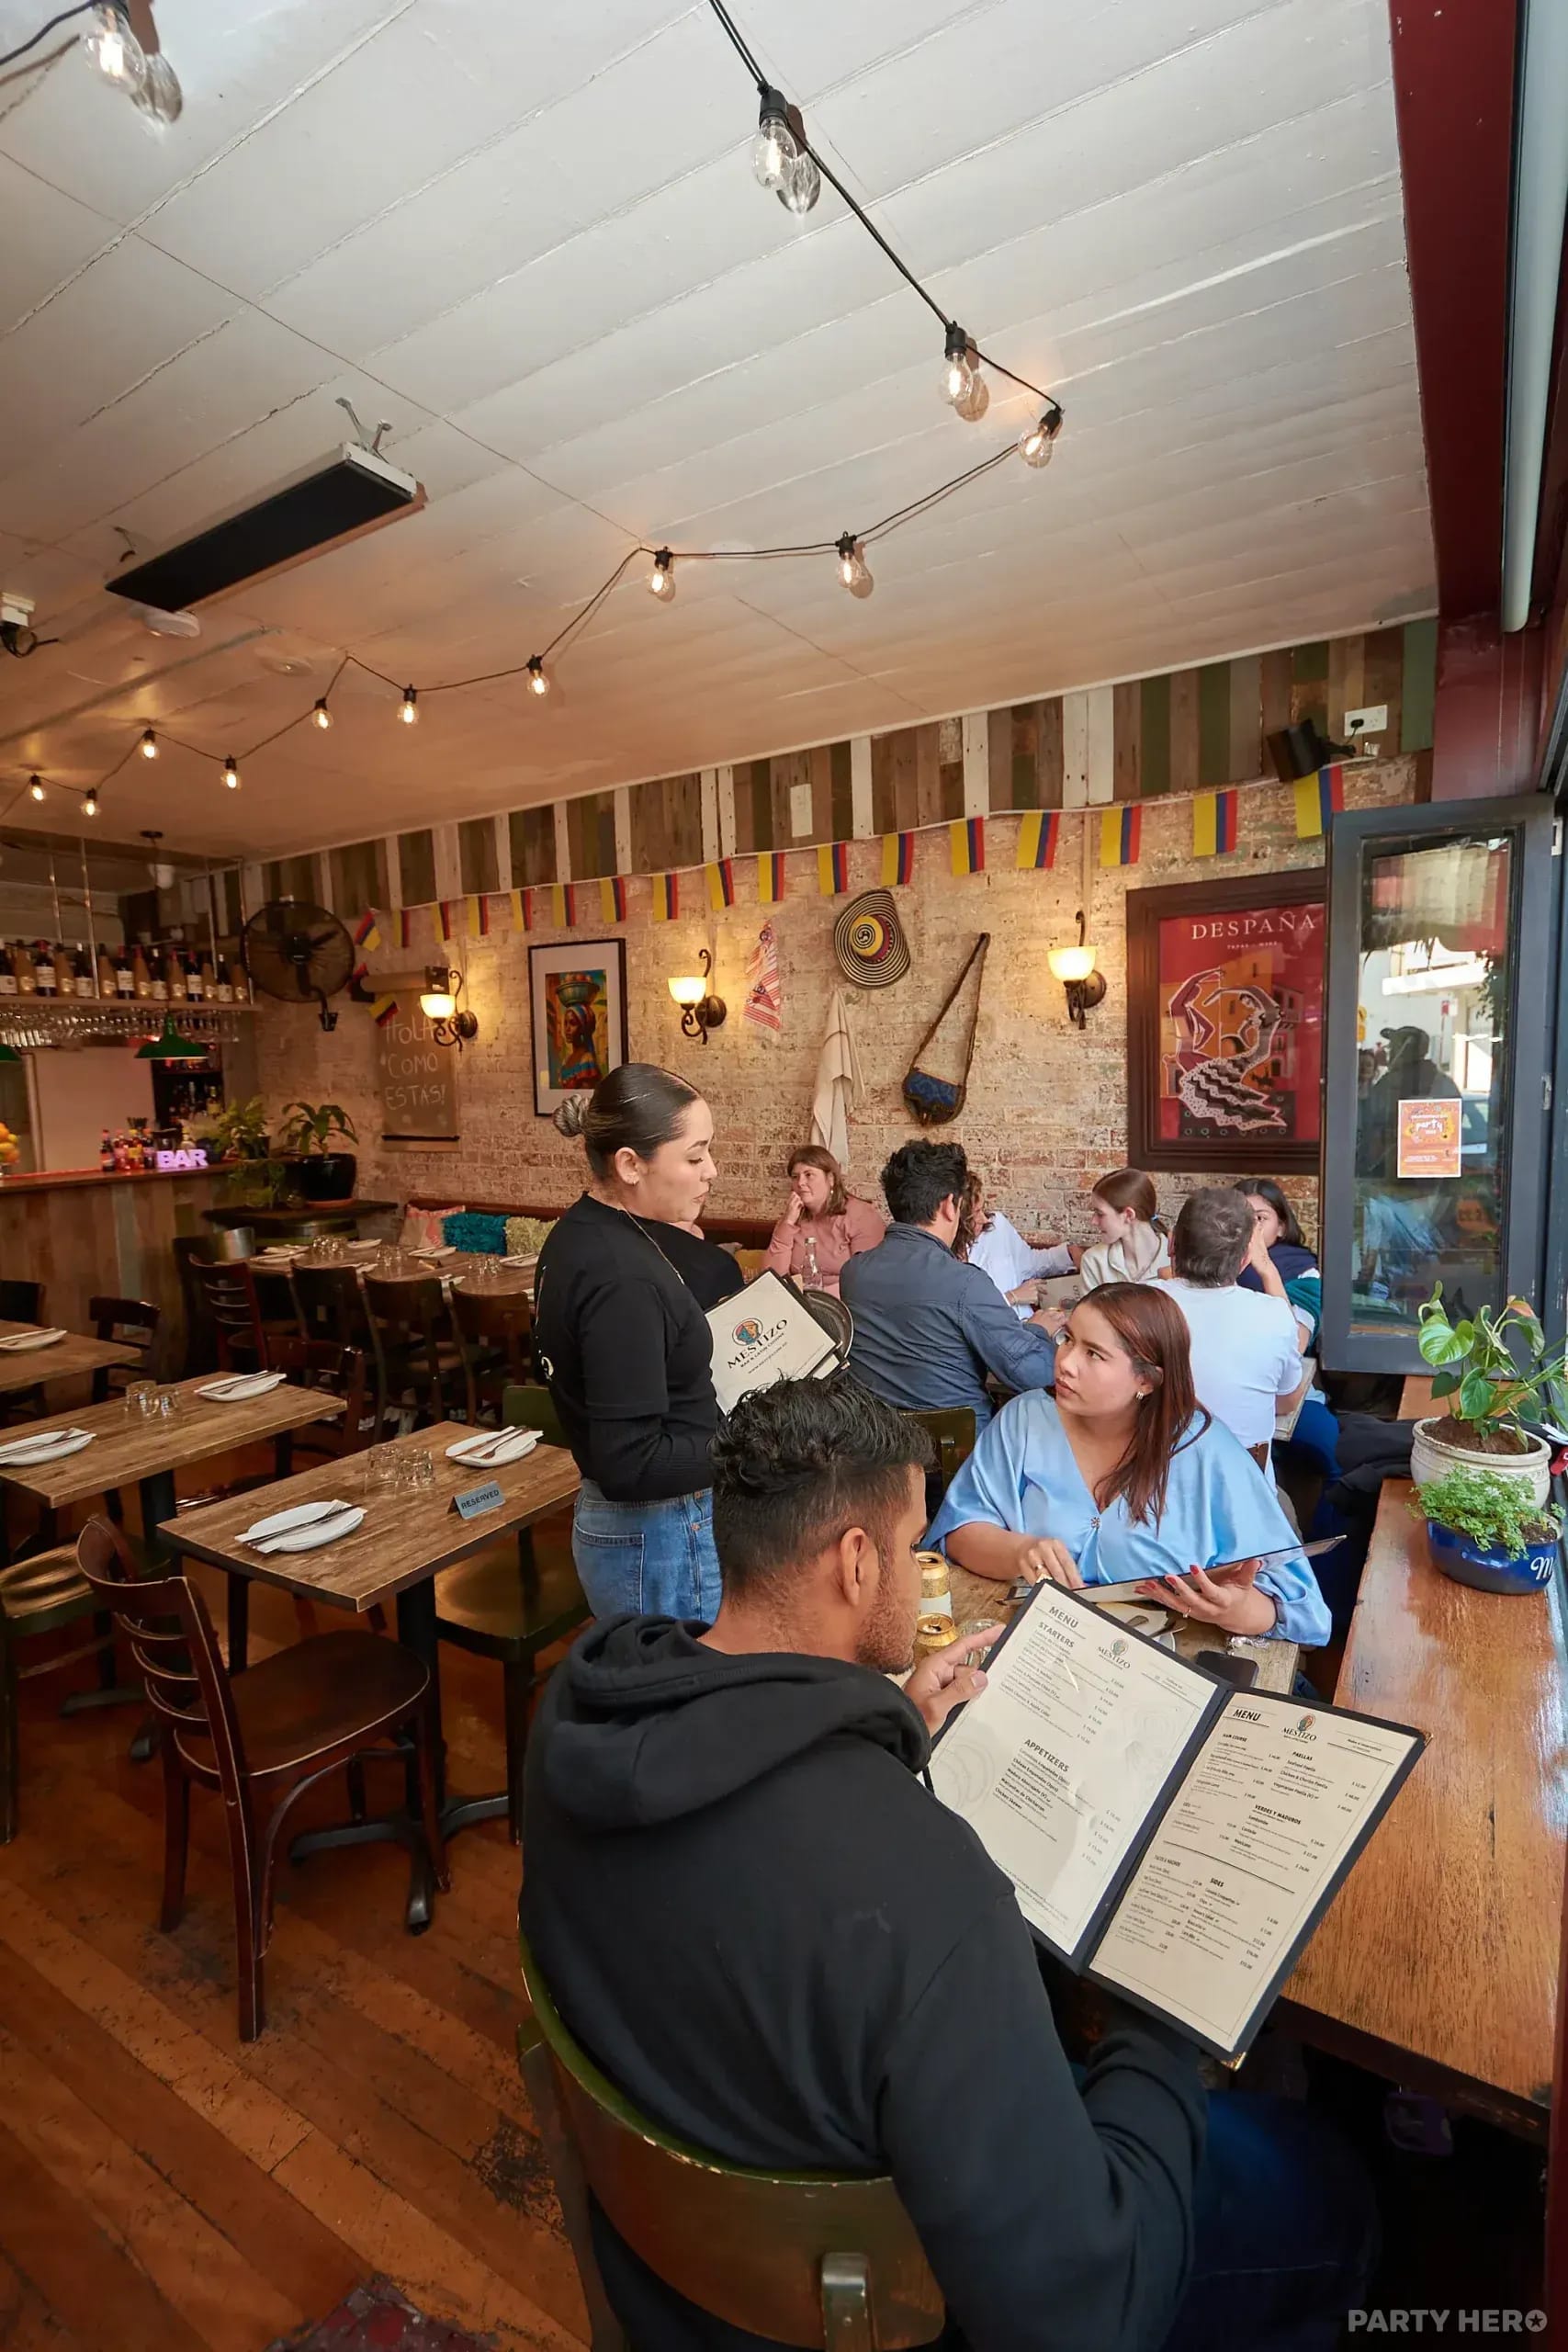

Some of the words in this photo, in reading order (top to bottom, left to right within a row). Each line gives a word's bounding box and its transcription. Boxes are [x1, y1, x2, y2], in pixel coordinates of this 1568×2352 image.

[1191, 911, 1316, 940] DESPAÑA
[386, 1014, 434, 1045] HOLA
[155, 1148, 209, 1169] BAR
[728, 1319, 787, 1369] MESTIZO
[461, 1489, 500, 1510] RESERVED
[1048, 1606, 1079, 1629] MENU
[1038, 1622, 1076, 1648] STARTERS
[1098, 1645, 1131, 1669] MESTIZO
[1233, 1708, 1261, 1722] MENU
[1282, 1726, 1317, 1742] MESTIZO
[1023, 1737, 1069, 1772] APPETIZERS
[1292, 1751, 1314, 1761] PAELLAS
[1253, 1804, 1272, 1814] VERDES
[1276, 1813, 1302, 1825] MADUROS
[1209, 1877, 1224, 1887] SIDES
